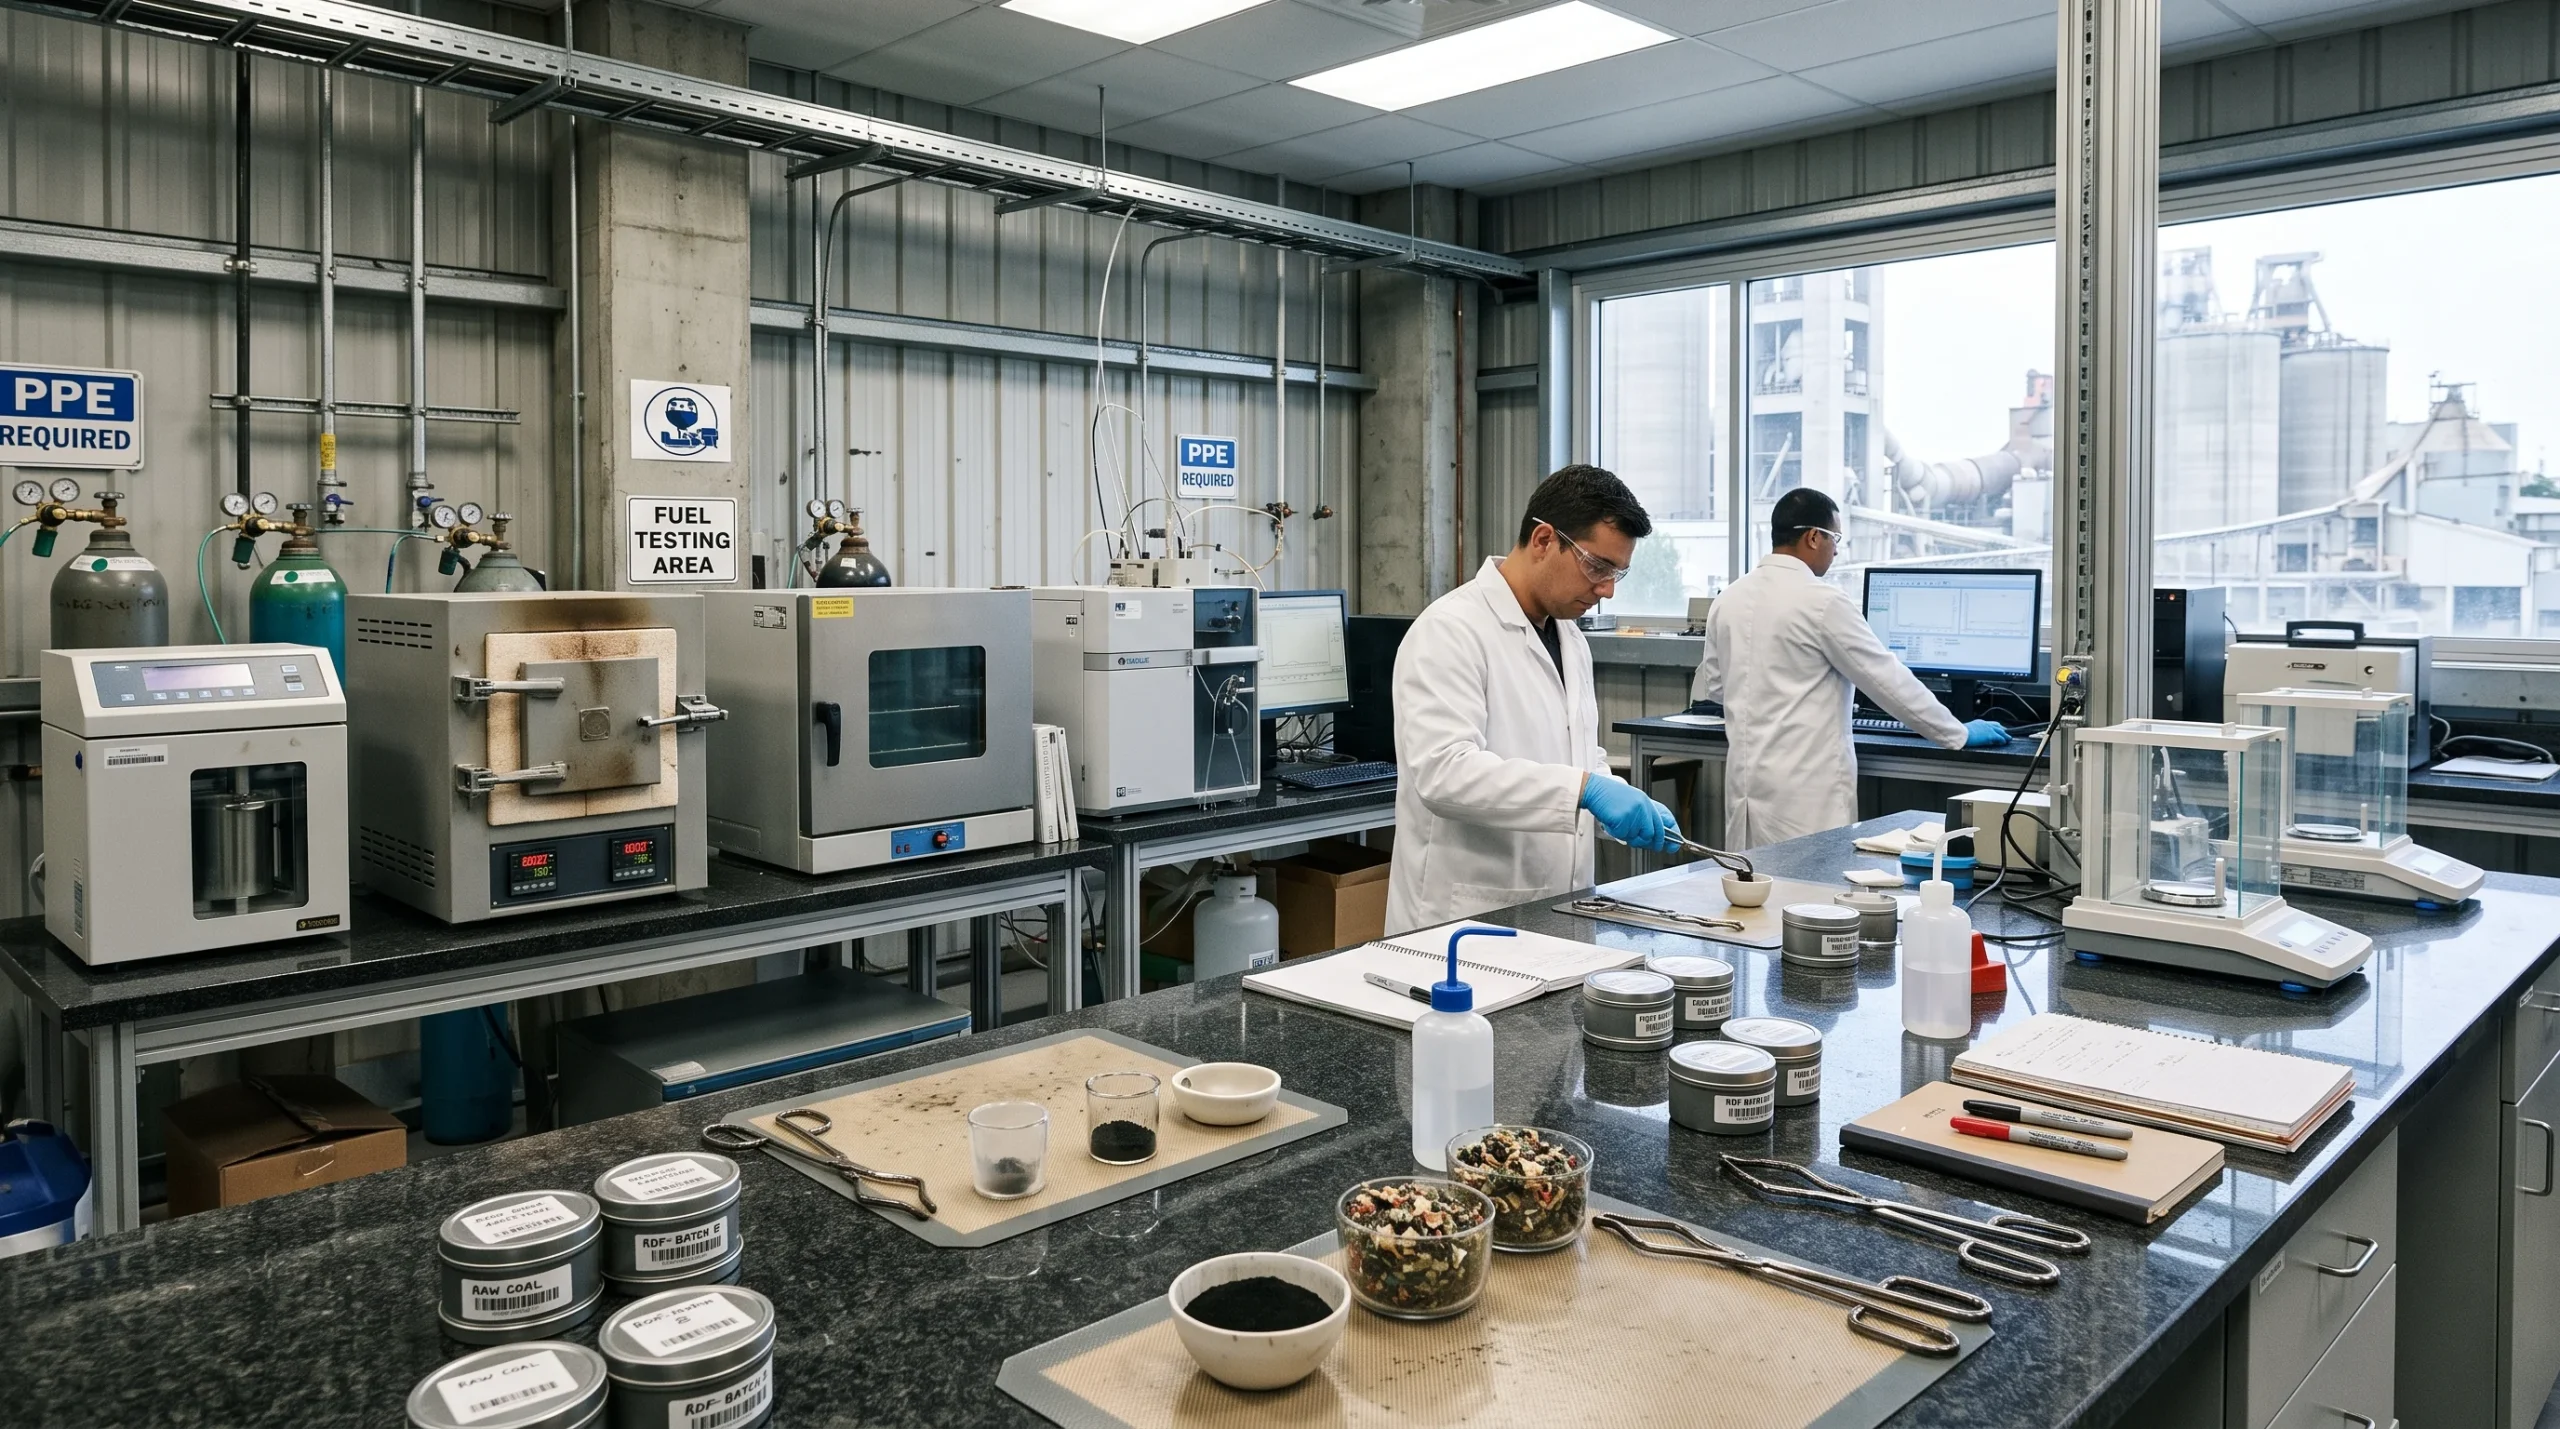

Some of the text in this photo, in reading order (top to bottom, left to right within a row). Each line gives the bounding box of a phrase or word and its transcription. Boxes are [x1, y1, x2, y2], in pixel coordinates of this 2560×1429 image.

[15, 377, 115, 416] PPE
[0, 424, 131, 451] REQUIRED
[1188, 442, 1229, 465] PPE
[1182, 472, 1234, 488] REQUIRED
[654, 506, 712, 525] FUEL
[634, 531, 731, 549] TESTING
[652, 556, 715, 574] AREA
[675, 1227, 710, 1245] BATCH
[472, 1280, 543, 1296] RAW COAL
[458, 1362, 540, 1389] RAW COAL
[725, 1376, 761, 1404] BATCH
